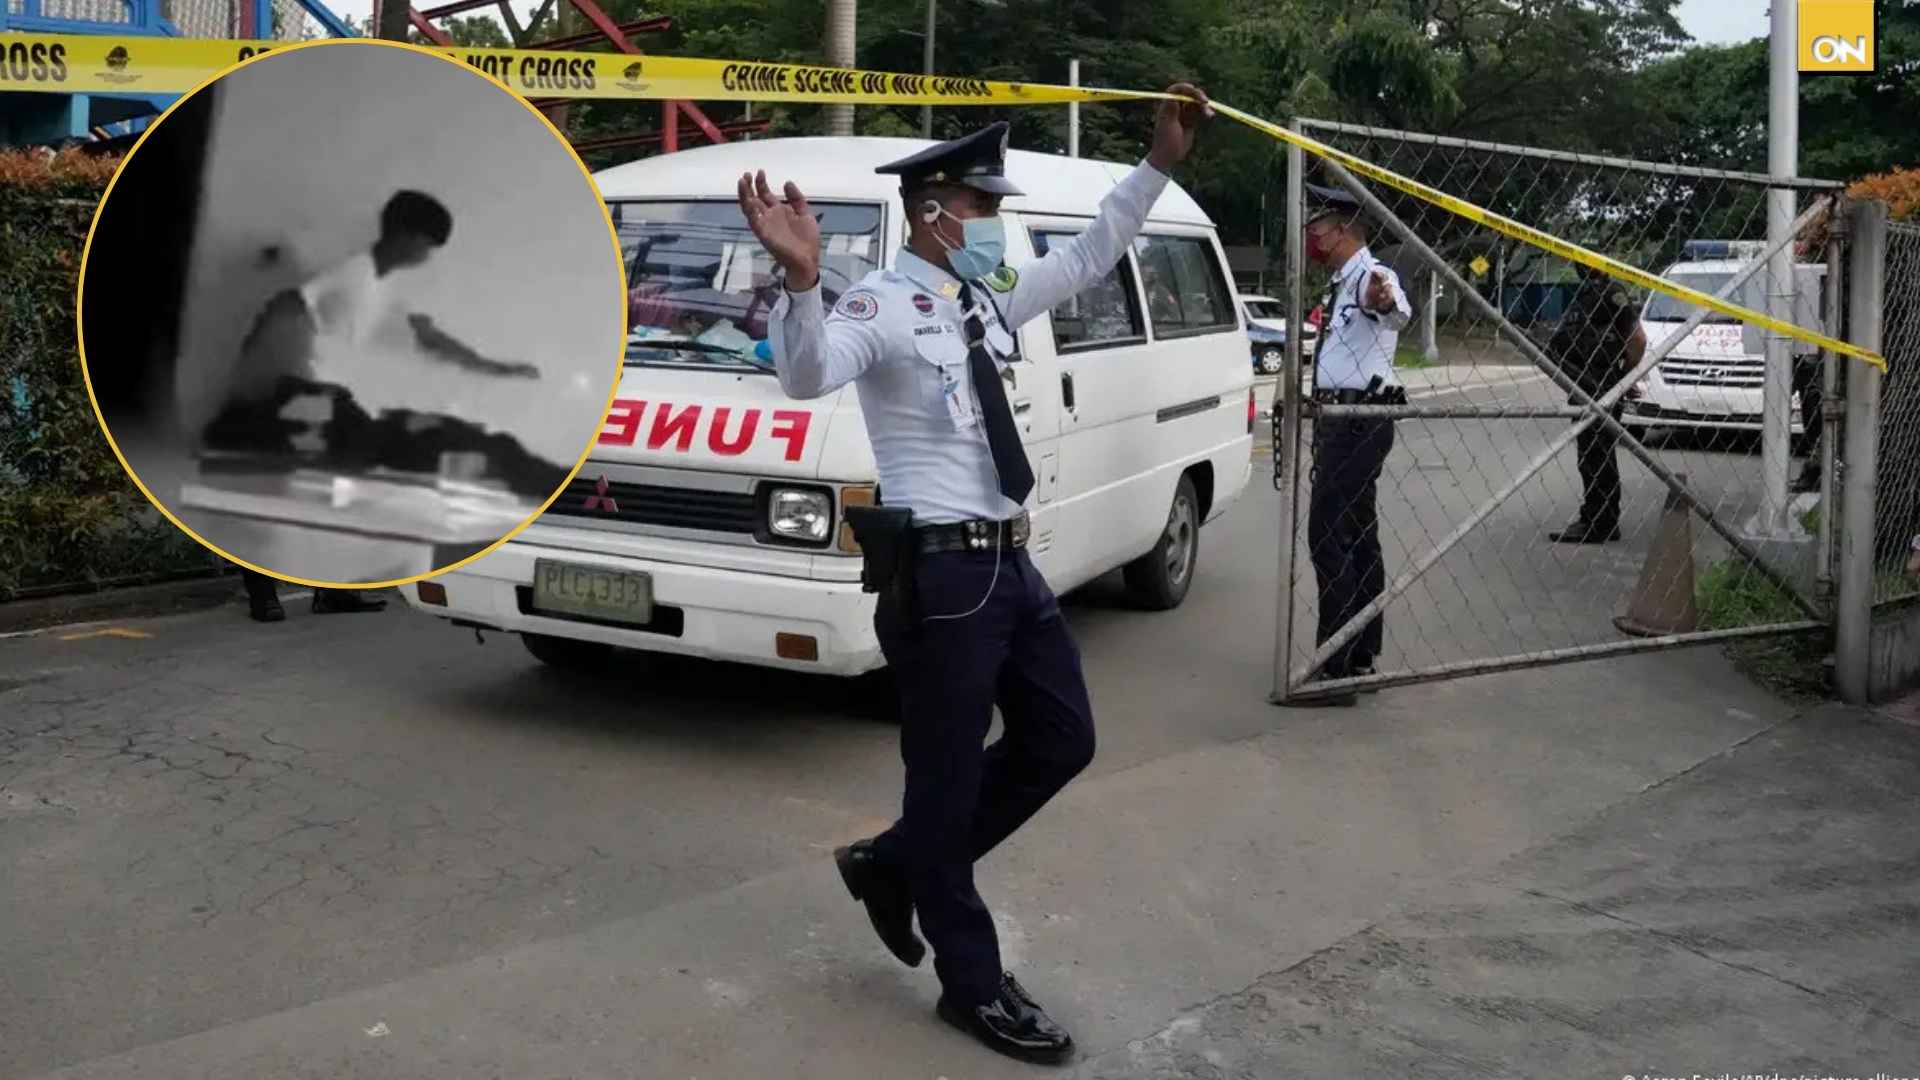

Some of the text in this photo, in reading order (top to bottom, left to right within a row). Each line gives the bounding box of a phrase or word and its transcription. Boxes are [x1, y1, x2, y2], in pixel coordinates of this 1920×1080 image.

[519, 56, 597, 90] CROSS
[722, 64, 790, 92] CRIME
[795, 68, 857, 94] SCENE
[861, 73, 888, 94] DO
[892, 74, 928, 95] NOT
